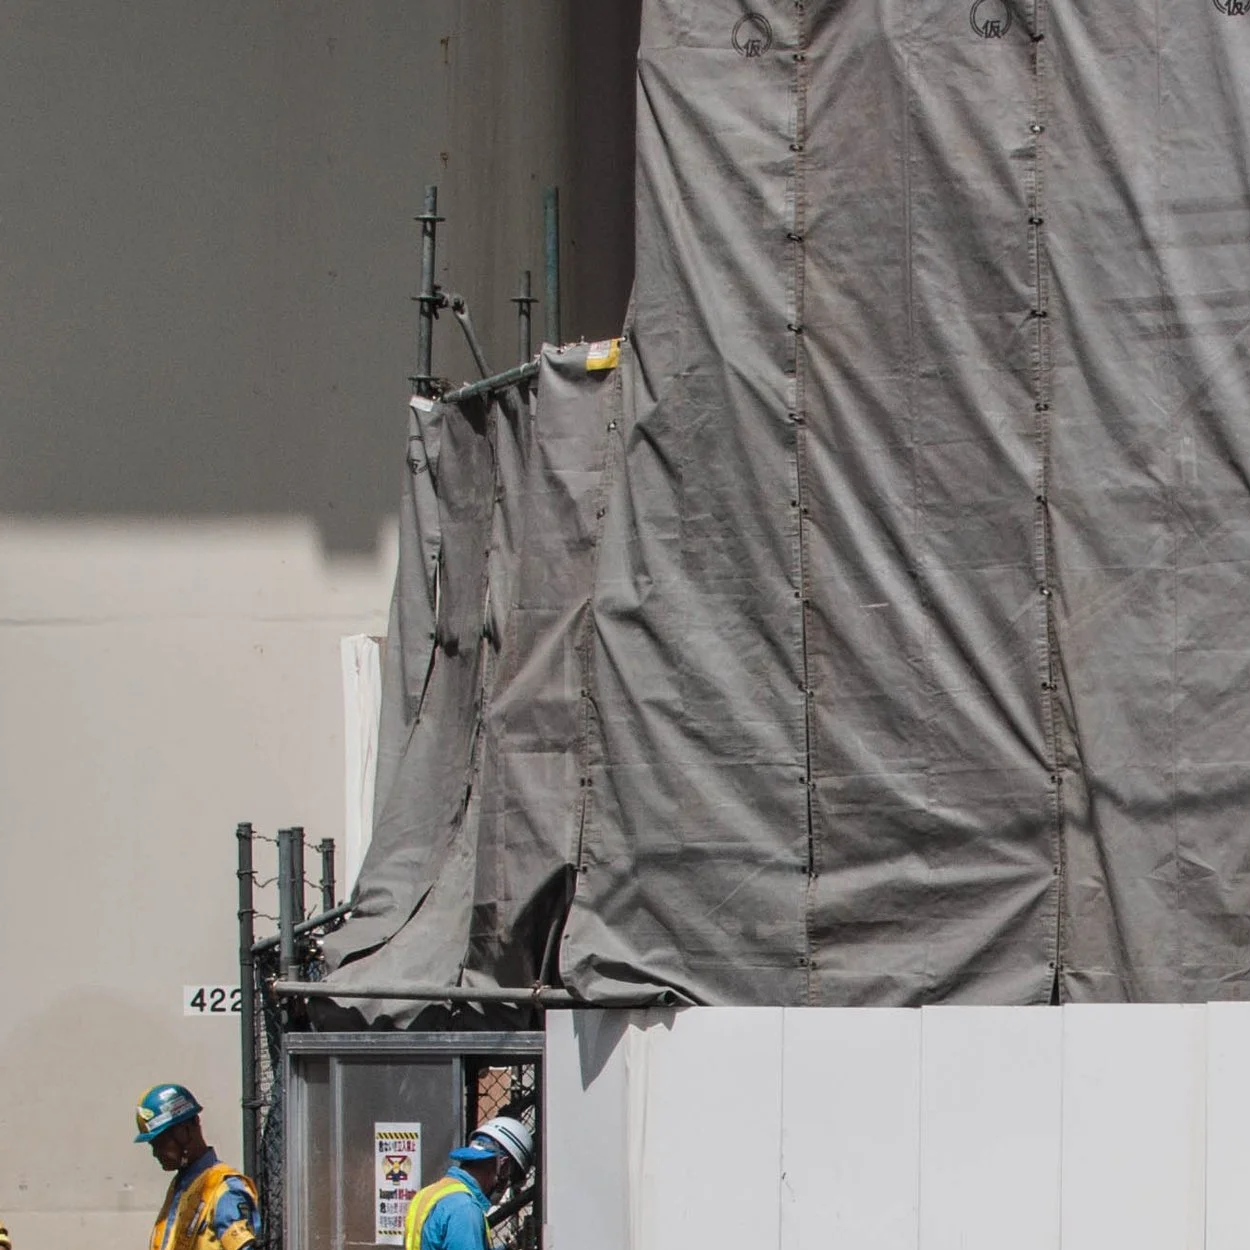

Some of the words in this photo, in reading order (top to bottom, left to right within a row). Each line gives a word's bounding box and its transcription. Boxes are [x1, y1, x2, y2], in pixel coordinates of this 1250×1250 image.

[982, 20, 1001, 38] 仮
[743, 39, 761, 57] 仮
[190, 988, 242, 1012] 422
